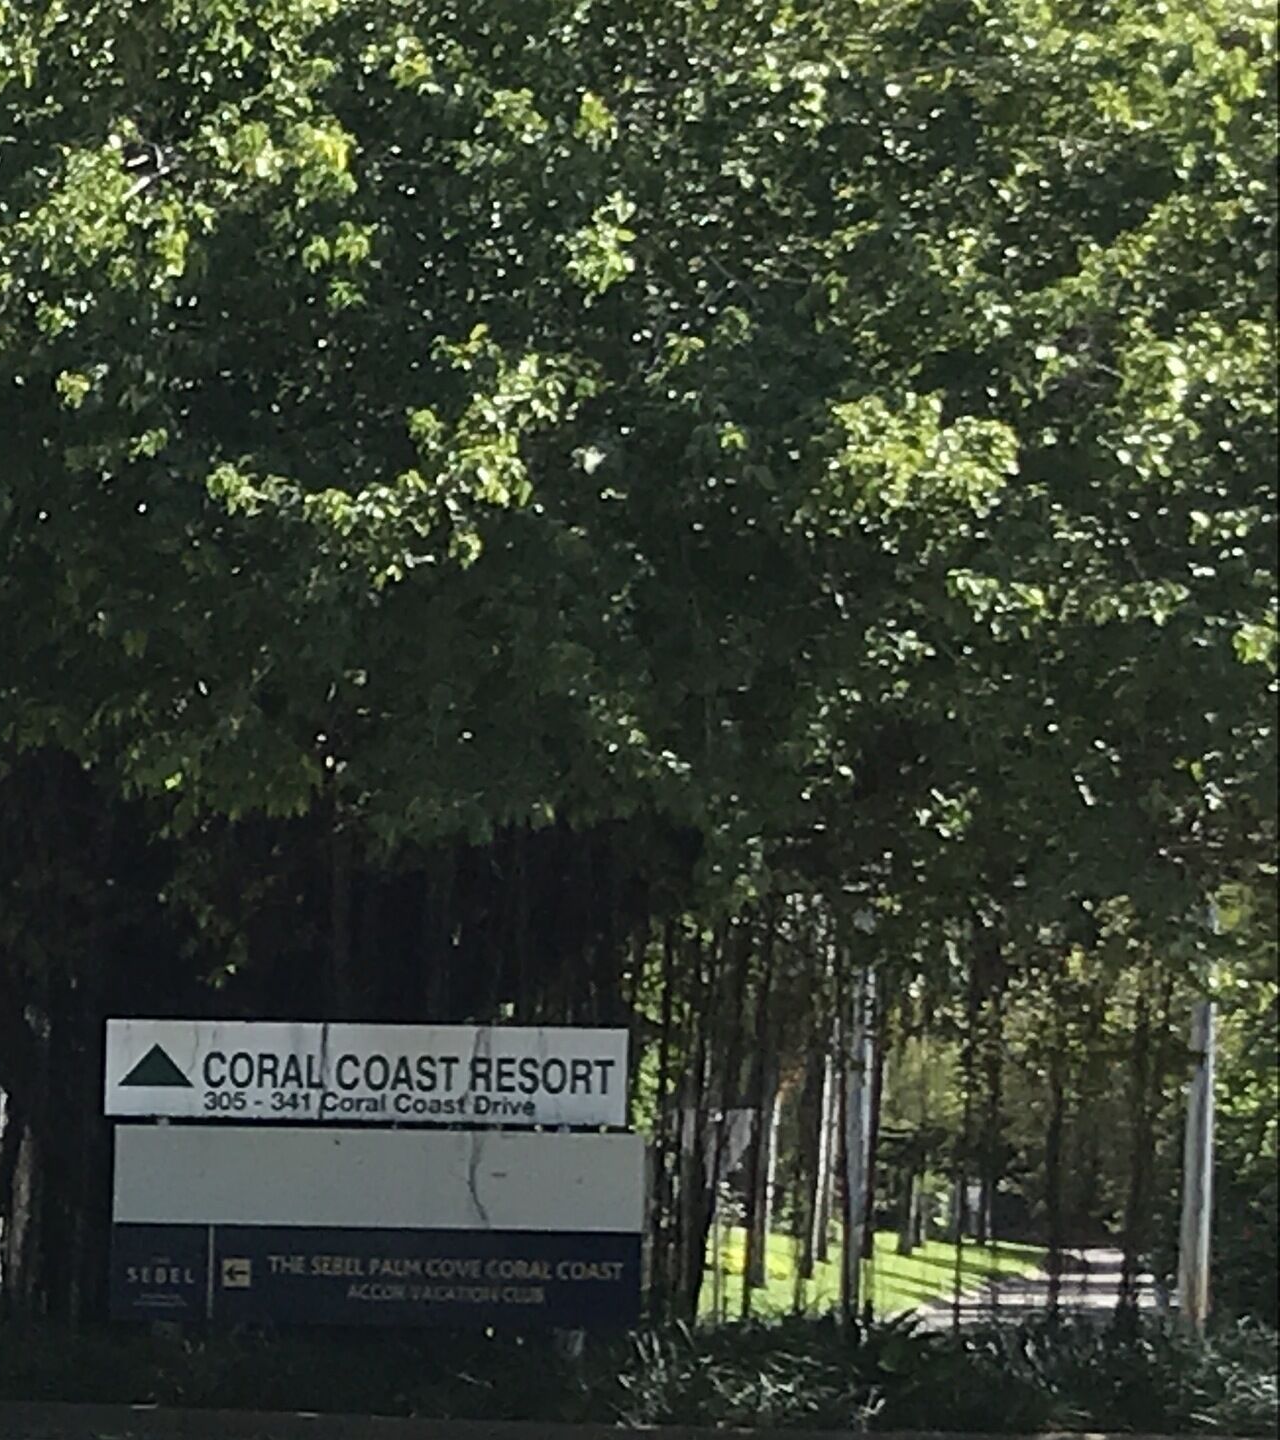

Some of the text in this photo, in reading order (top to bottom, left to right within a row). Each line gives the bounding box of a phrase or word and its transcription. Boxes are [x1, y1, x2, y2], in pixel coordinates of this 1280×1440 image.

[203, 1051, 616, 1095] CORAL COAST RESORT
[204, 1091, 246, 1111] 305
[271, 1091, 311, 1112] 341
[322, 1091, 387, 1113] Coral
[394, 1093, 467, 1115] Coast
[473, 1095, 537, 1117] Drive
[267, 1255, 306, 1274] THE
[369, 1257, 422, 1277] PALM
[426, 1259, 481, 1279] COVE
[484, 1259, 552, 1280] CORAL
[556, 1261, 624, 1281] COAST
